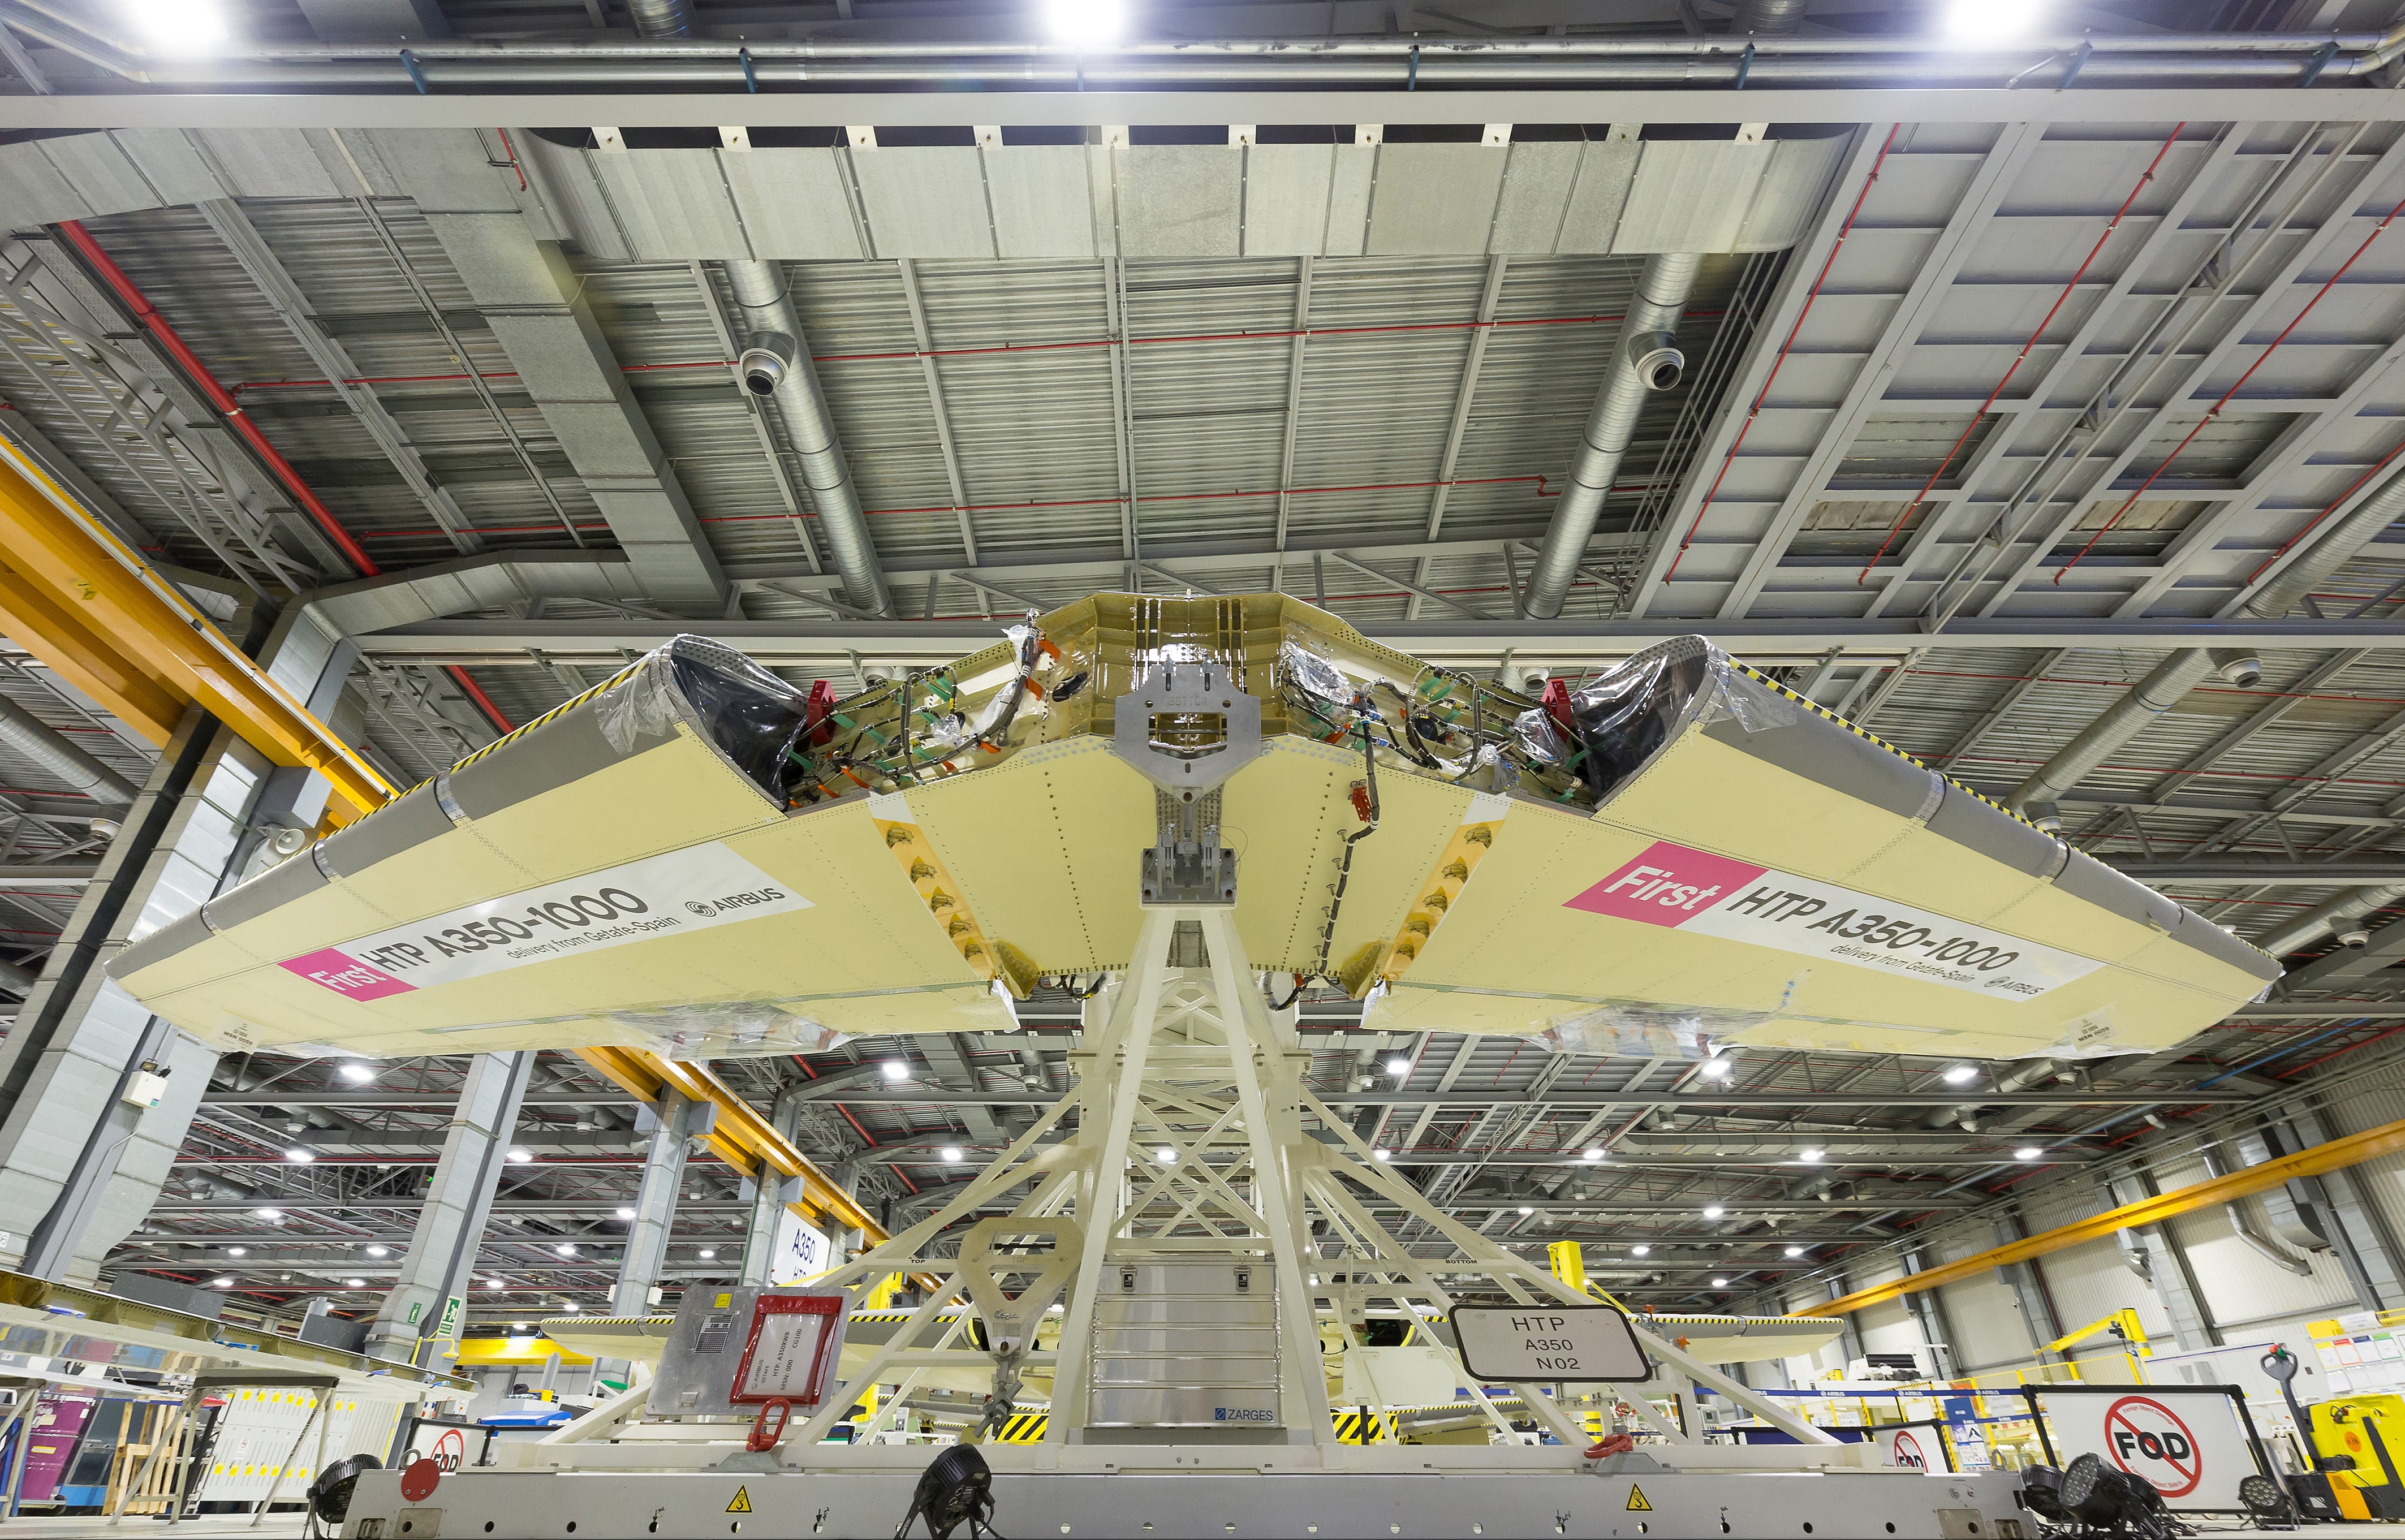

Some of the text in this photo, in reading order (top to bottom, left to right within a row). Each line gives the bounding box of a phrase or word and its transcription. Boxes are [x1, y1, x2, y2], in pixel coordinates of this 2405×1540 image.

[712, 887, 785, 911] AIRBUS
[1603, 865, 2019, 971] First HTP A350-1000
[308, 887, 648, 991] First HTP A350-1000
[507, 916, 682, 959] delivery from Getafe-Spain
[1830, 944, 1975, 983] delivery from Getafe-Spain
[1999, 980, 2044, 995] AIRBUS
[792, 1228, 815, 1264] A350
[1511, 1317, 1564, 1331] HTP
[1525, 1339, 1573, 1351] A350
[1536, 1357, 1581, 1370] N02
[1228, 1409, 1273, 1421] ZARGES
[2114, 1431, 2190, 1460] FOD
[434, 1453, 459, 1473] FOD
